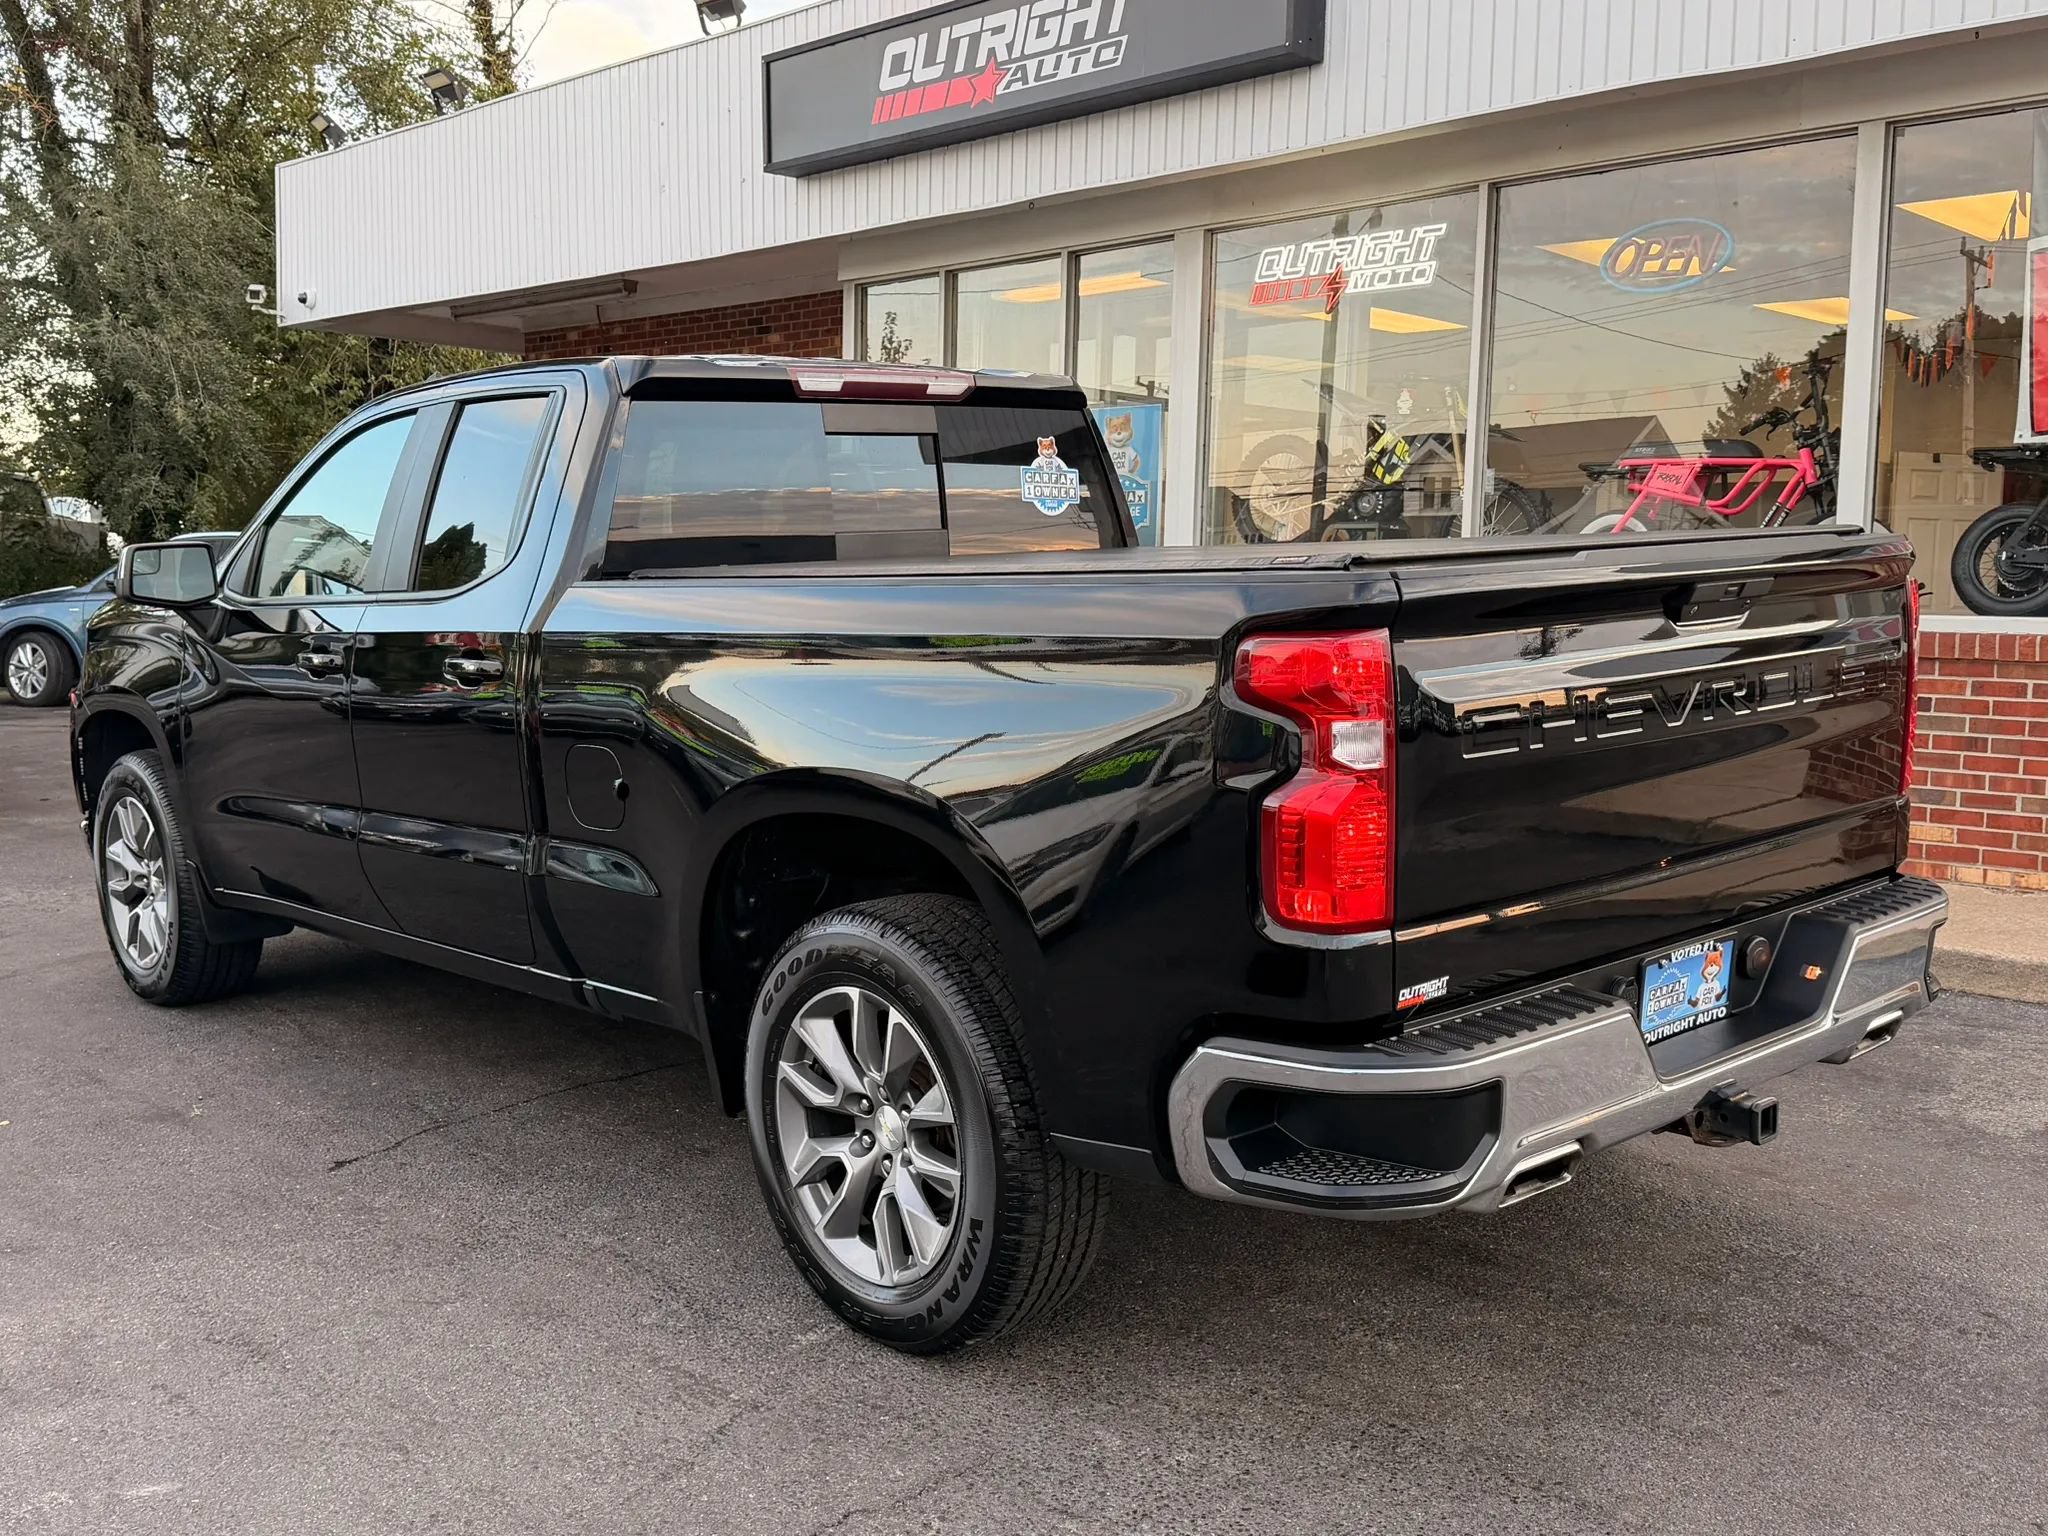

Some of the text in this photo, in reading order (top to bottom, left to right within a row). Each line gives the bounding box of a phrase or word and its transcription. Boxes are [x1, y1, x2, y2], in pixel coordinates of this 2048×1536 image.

[1001, 38, 1124, 92] AUTO
[1255, 223, 1447, 282] OUTRIGHT
[1607, 231, 1724, 279] OPEN
[1351, 265, 1432, 289] MOTO
[1112, 451, 1126, 460] CAR
[1025, 472, 1075, 486] CARFAX
[1462, 651, 1901, 759] CHEVROLET
[1671, 940, 1714, 963] VOTED #1
[762, 944, 923, 1016] GOODYEAR
[1398, 975, 1450, 1002] OUTRIGHT
[1650, 979, 1687, 1001] CARFAX
[1643, 1006, 1727, 1044] OUTRIGHT AUTO
